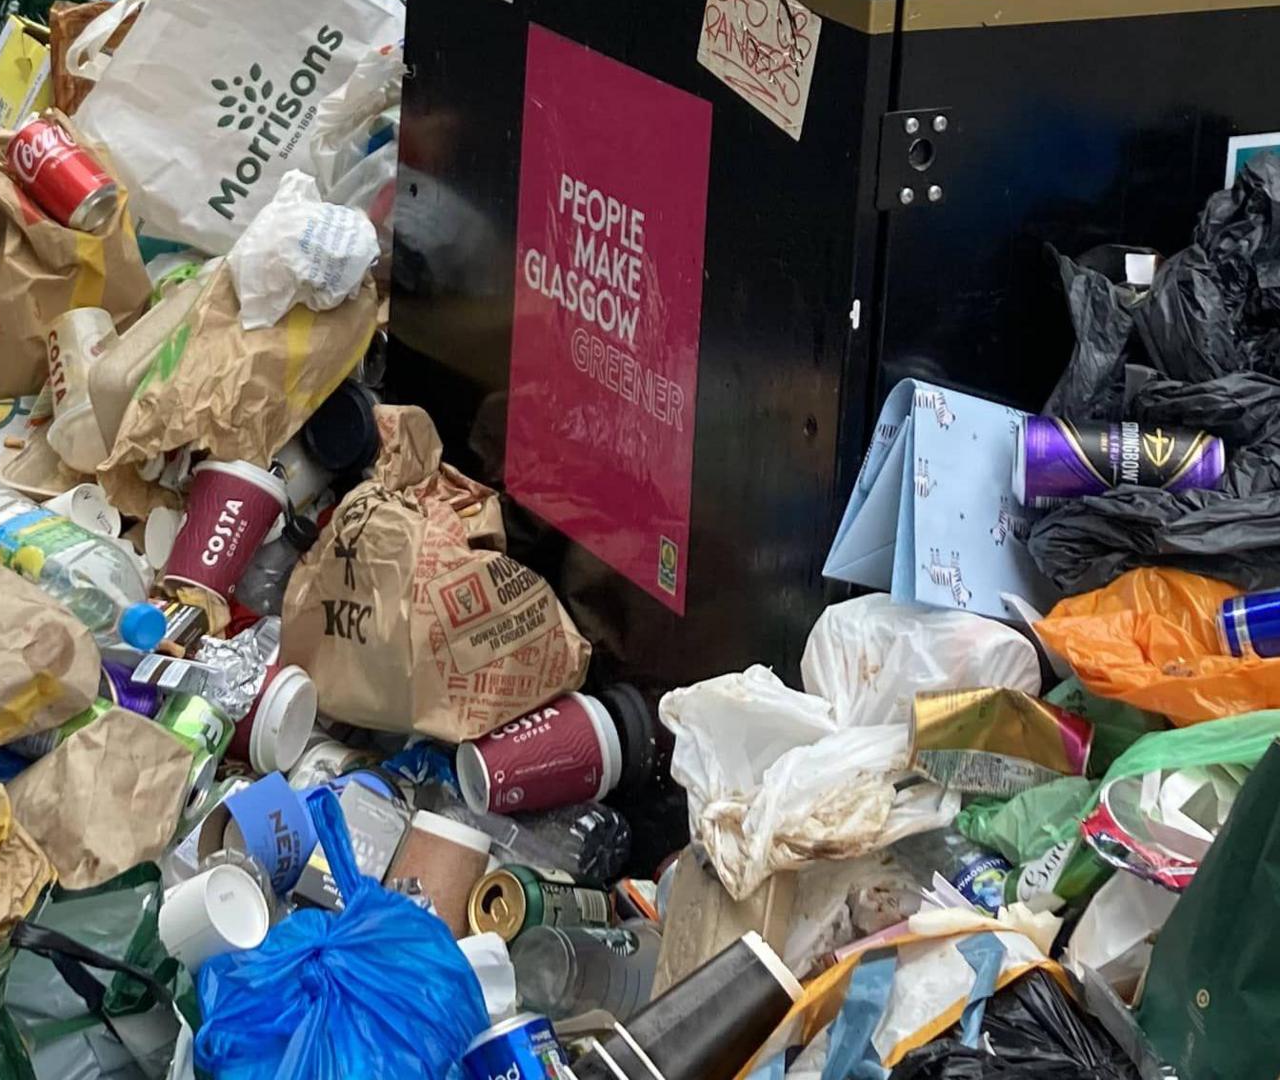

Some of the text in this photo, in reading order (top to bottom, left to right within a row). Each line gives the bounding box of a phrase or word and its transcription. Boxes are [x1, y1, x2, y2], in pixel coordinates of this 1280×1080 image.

[208, 24, 345, 221] Morrisons
[278, 104, 319, 161] Since 1899
[559, 173, 644, 256] PEOPLE
[524, 248, 640, 346] GLASGOW
[573, 228, 642, 303] MAKE
[47, 329, 67, 407] COSTA
[570, 327, 684, 432] GREENER
[201, 499, 244, 567] COSTA
[226, 518, 249, 559] COFFEE
[320, 599, 373, 645] KFC
[469, 615, 514, 647] DOWNLOAD
[489, 638, 501, 651] TO
[501, 624, 525, 646] ORDER
[512, 722, 552, 743] COFFEE
